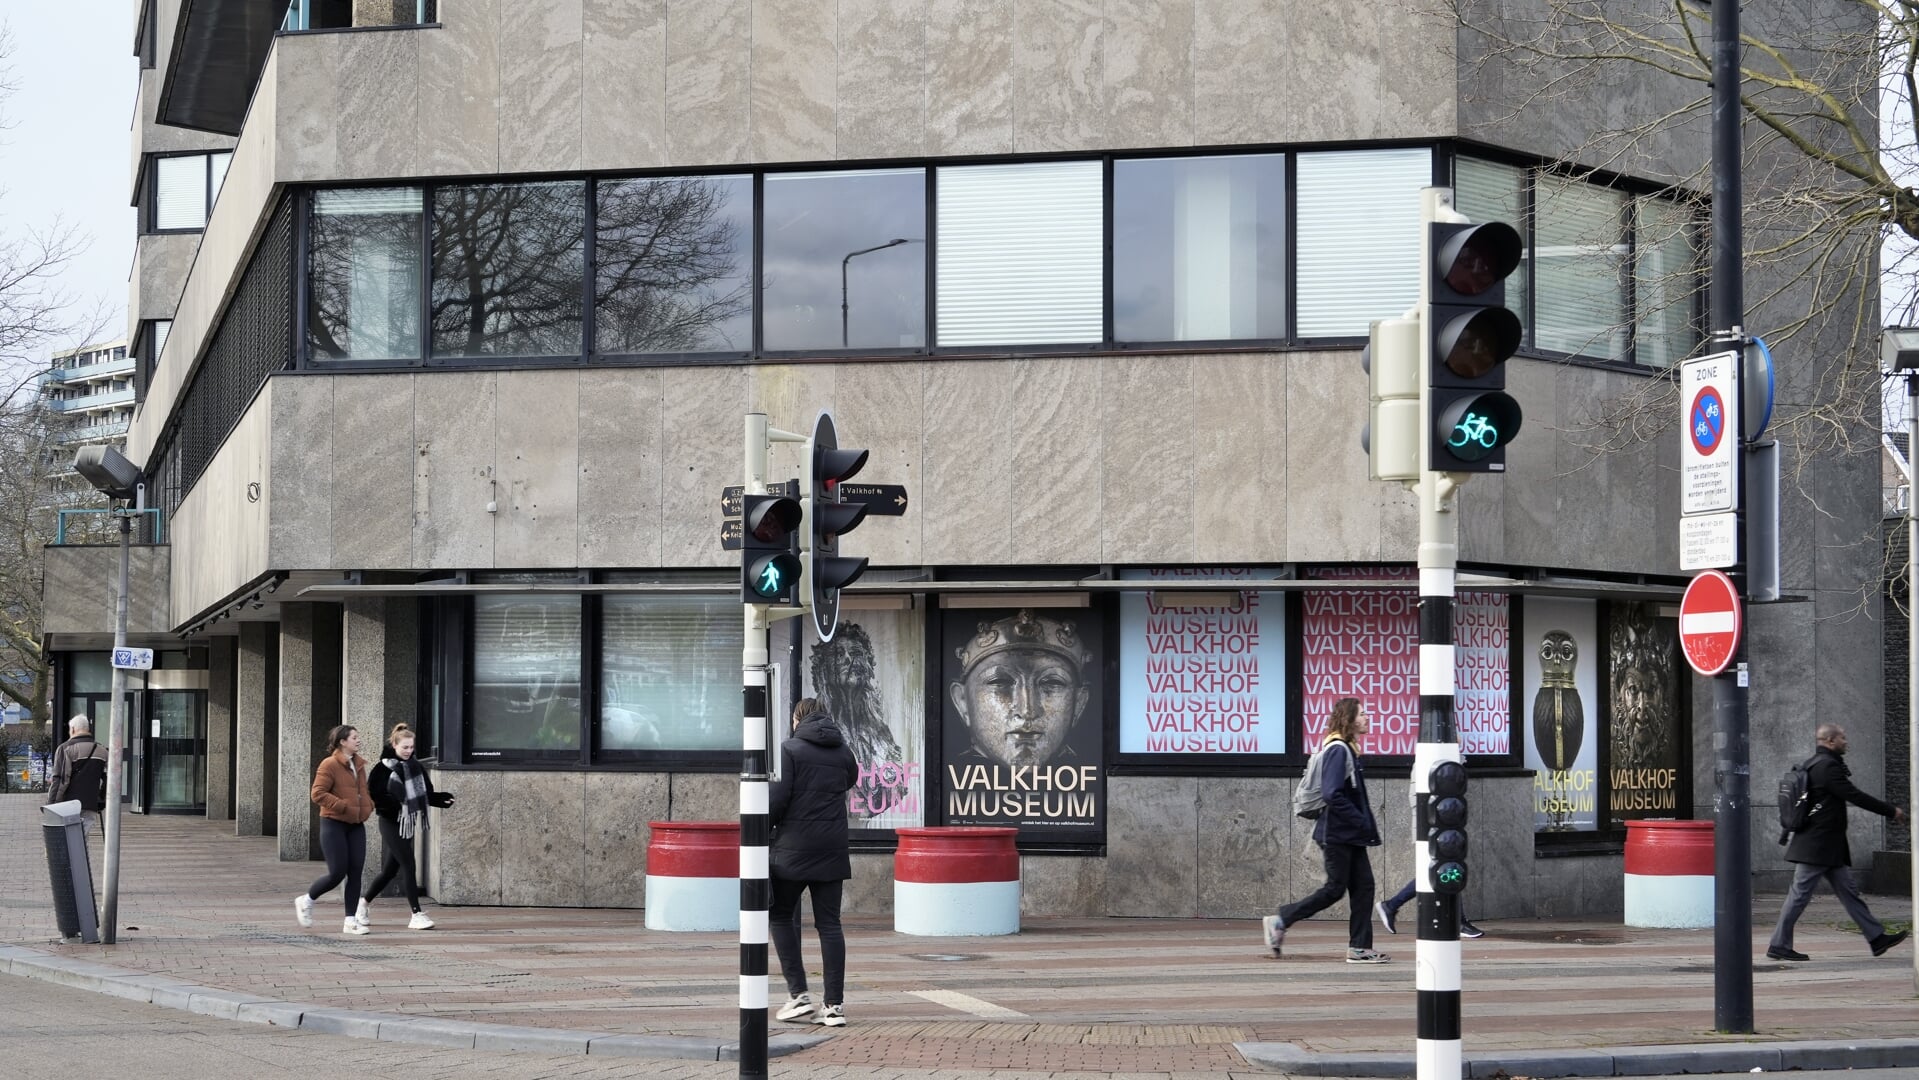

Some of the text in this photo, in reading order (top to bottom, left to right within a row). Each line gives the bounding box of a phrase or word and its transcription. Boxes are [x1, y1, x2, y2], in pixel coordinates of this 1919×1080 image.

[1696, 366, 1718, 381] ZONE
[847, 487, 875, 495] Valkhof
[1303, 596, 1419, 616] VALKHOF
[1146, 615, 1259, 634] MUSEUM
[1303, 616, 1417, 635] MUSEUM
[1455, 607, 1508, 628] USEUM
[1145, 635, 1260, 654] VALKHOF
[1303, 636, 1419, 655] VALKHOF
[1454, 627, 1510, 649] ALKHOF
[1146, 654, 1259, 673] MUSEUM
[1303, 655, 1417, 675] MUSEUM
[1455, 648, 1508, 669] USEUM
[1145, 674, 1260, 694] VALKHOF
[1303, 675, 1419, 695] VALKHOF
[1454, 669, 1510, 690] ALKHOF
[1146, 694, 1259, 713] MUSEUM
[1303, 695, 1417, 715] MEUM
[1455, 690, 1508, 711] USEUM
[1145, 713, 1260, 733] VALKHOF
[1303, 715, 1419, 735] VAHOF
[1454, 711, 1510, 733] ALKHOF
[1146, 733, 1259, 753] MUSEUM
[1303, 734, 1416, 754] MEUM
[948, 764, 1097, 791] VALKHOF
[1533, 769, 1594, 791] ALKHOF
[1610, 768, 1676, 790] VALKHOF
[949, 791, 1095, 817] MUSEUM
[1610, 790, 1676, 811] MUSEUM
